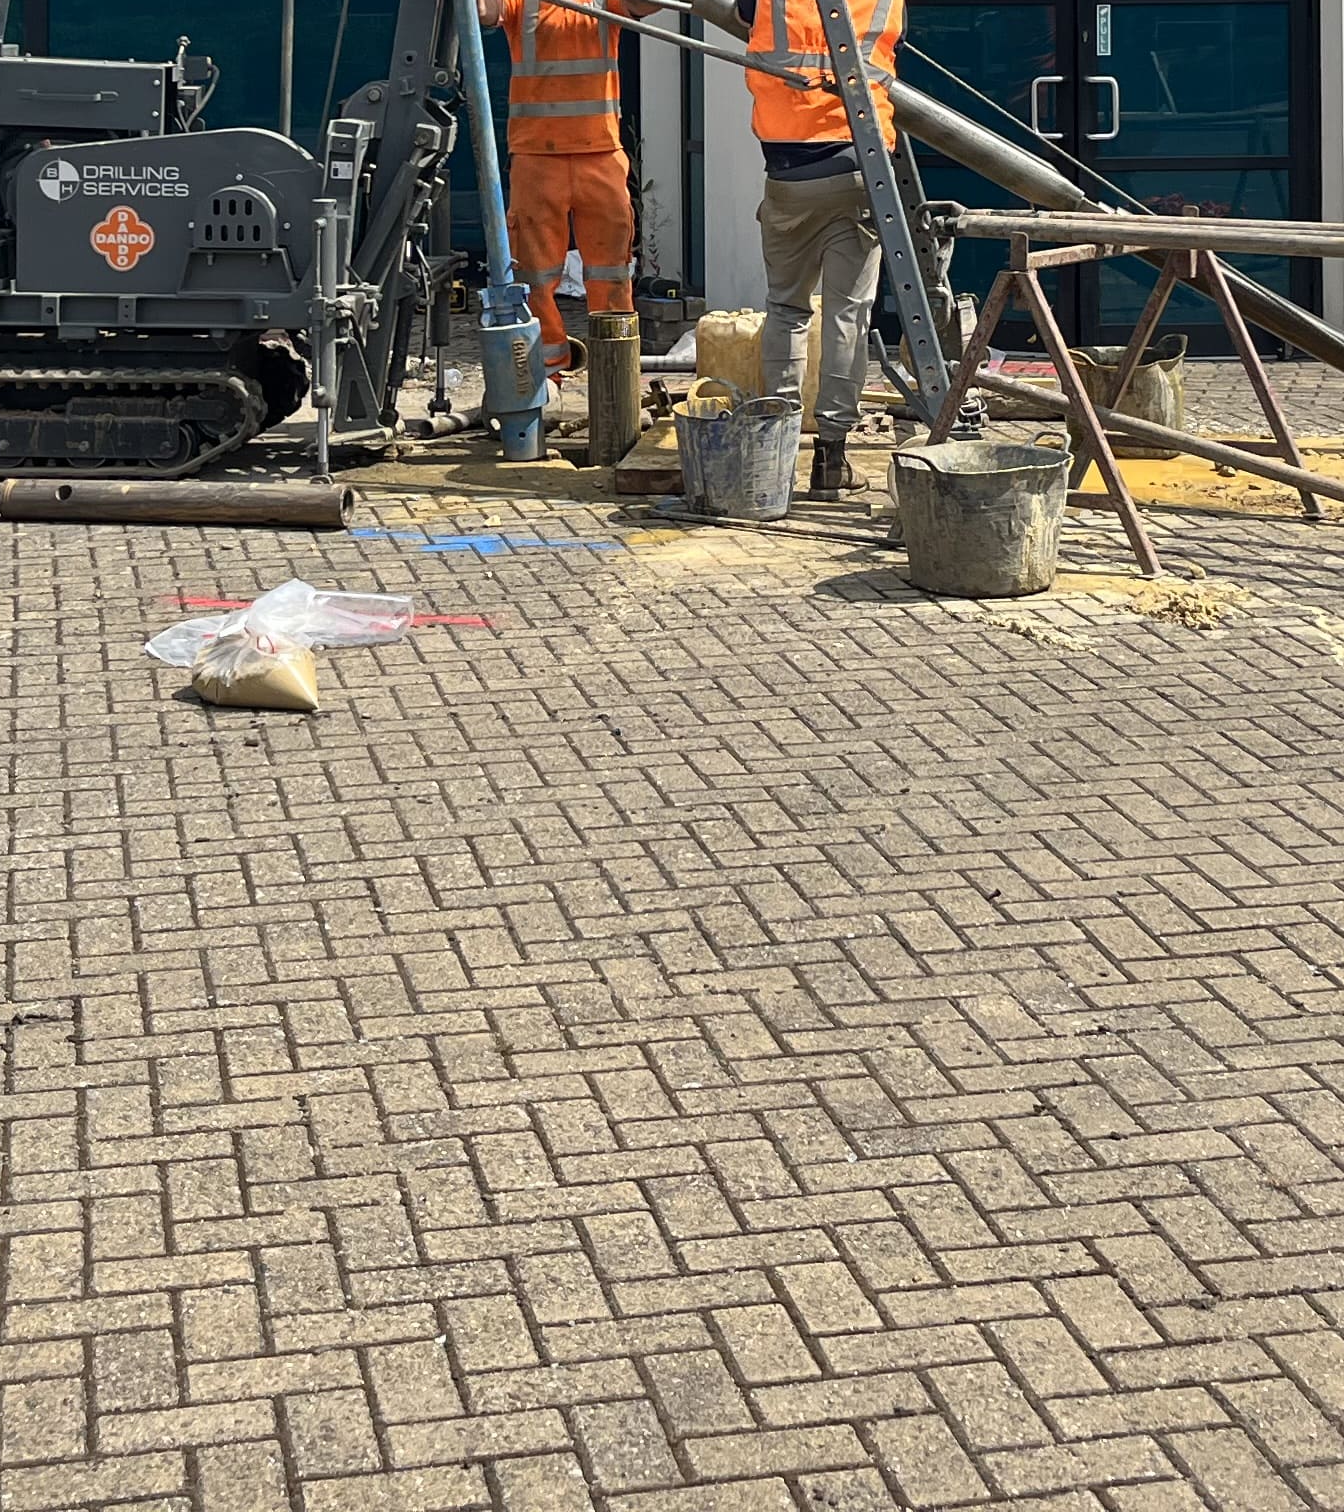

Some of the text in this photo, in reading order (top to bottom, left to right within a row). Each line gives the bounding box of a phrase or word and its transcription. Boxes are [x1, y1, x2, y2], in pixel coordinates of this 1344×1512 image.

[83, 165, 180, 180] DRILLING
[83, 182, 189, 197] SERVICES
[95, 233, 150, 245] DANDO
[117, 211, 129, 266] DANDO
